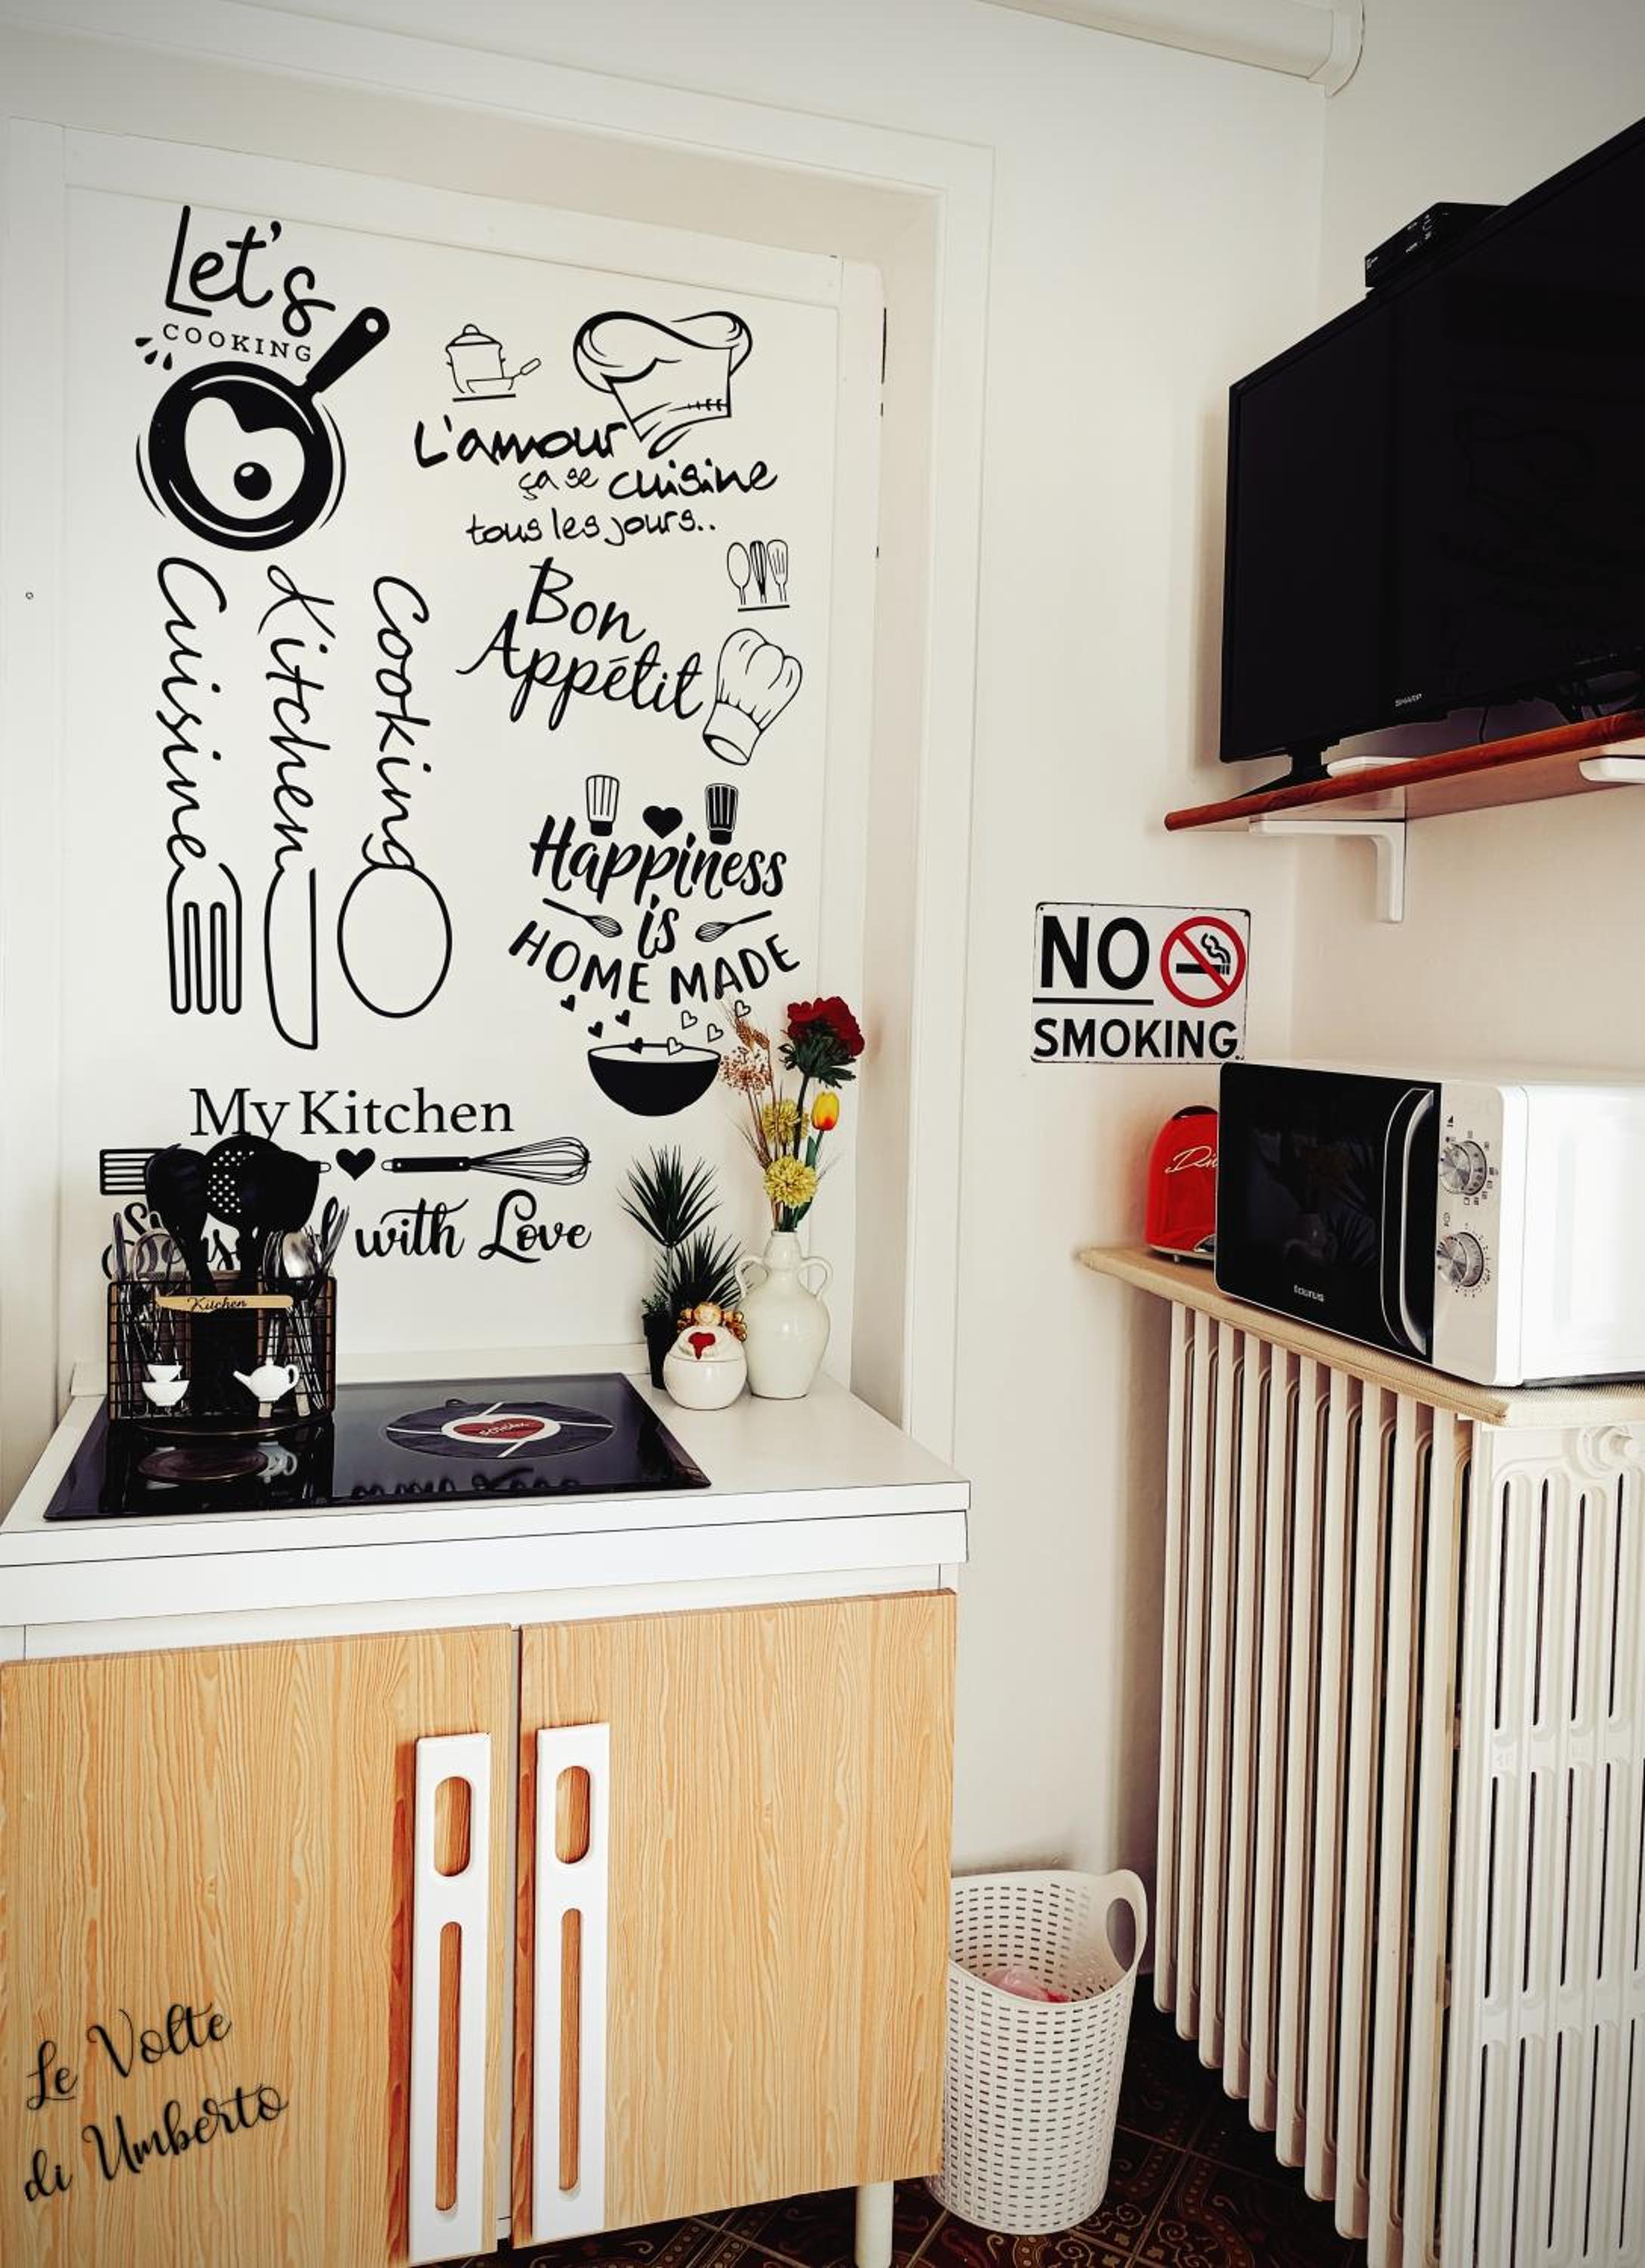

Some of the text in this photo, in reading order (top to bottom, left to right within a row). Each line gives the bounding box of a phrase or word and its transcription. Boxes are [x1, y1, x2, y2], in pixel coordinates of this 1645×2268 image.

[166, 206, 336, 337] Let's
[163, 324, 311, 361] COOKING
[414, 414, 627, 467] L'amour
[519, 458, 778, 500] ça se cuisine
[466, 514, 543, 545] tous
[551, 507, 600, 540] les
[526, 557, 646, 643] Bon
[456, 609, 704, 730] Appétit
[156, 557, 227, 869] Cuisine
[259, 565, 336, 871] Kitchen
[361, 576, 431, 869] Cooking
[530, 815, 787, 906] Happiness
[509, 921, 801, 1005] HOME MADE
[637, 894, 680, 960] is
[1041, 916, 1150, 990] NO
[1034, 1018, 1238, 1058] SMOKING
[190, 1087, 515, 1140] My Kitchen
[355, 1198, 469, 1259] with
[478, 1188, 592, 1263] Love
